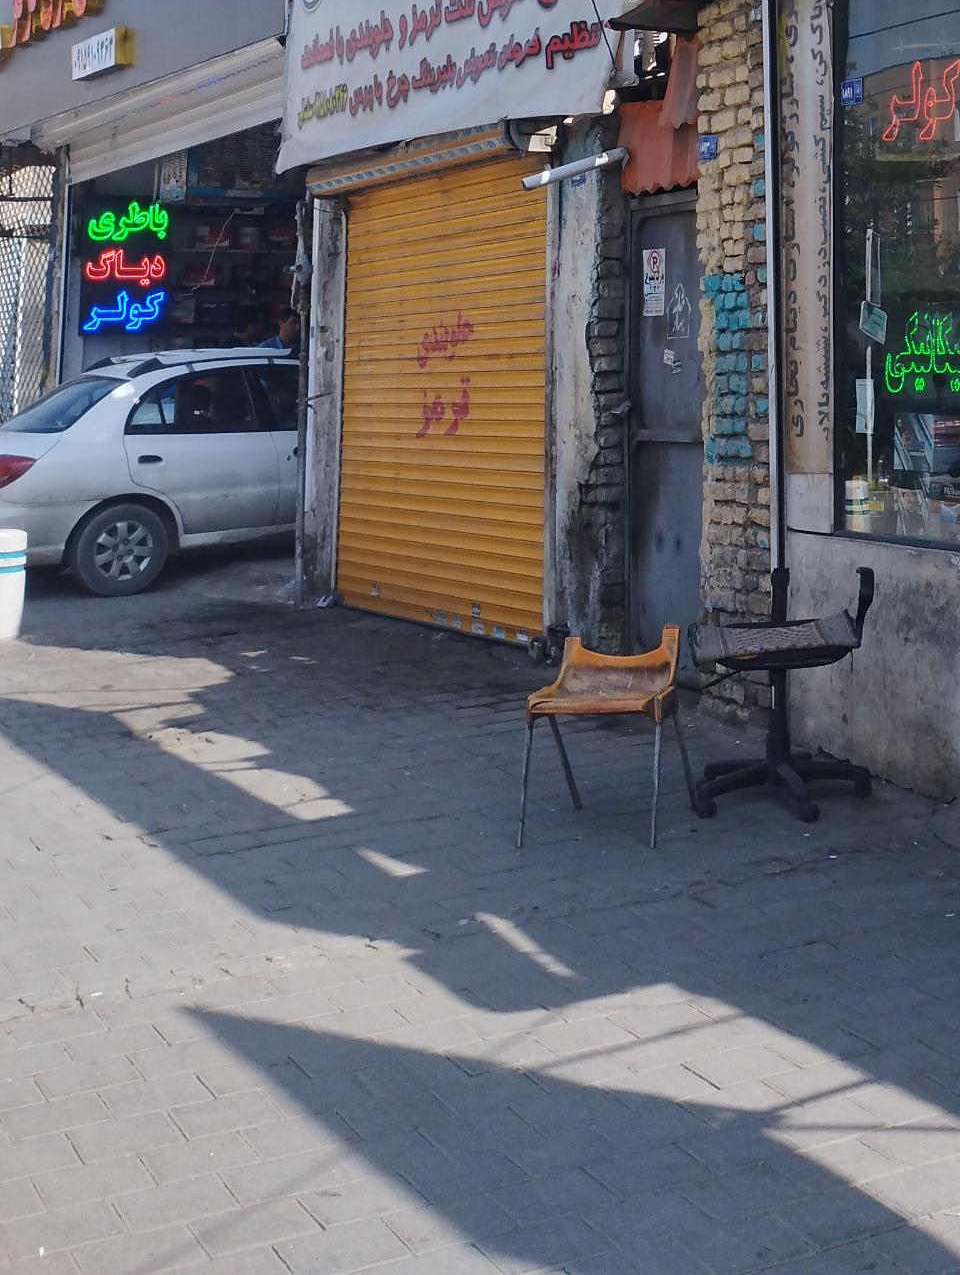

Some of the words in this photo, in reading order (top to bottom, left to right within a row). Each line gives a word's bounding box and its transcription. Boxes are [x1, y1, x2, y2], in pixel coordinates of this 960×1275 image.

[346, 10, 394, 61] جلوبندی
[497, 26, 541, 71] فرمان
[545, 20, 602, 70] تنظیم
[386, 69, 410, 108] چرخ
[882, 59, 960, 142] کولر
[88, 200, 168, 241] باطری
[83, 290, 165, 331] کولر
